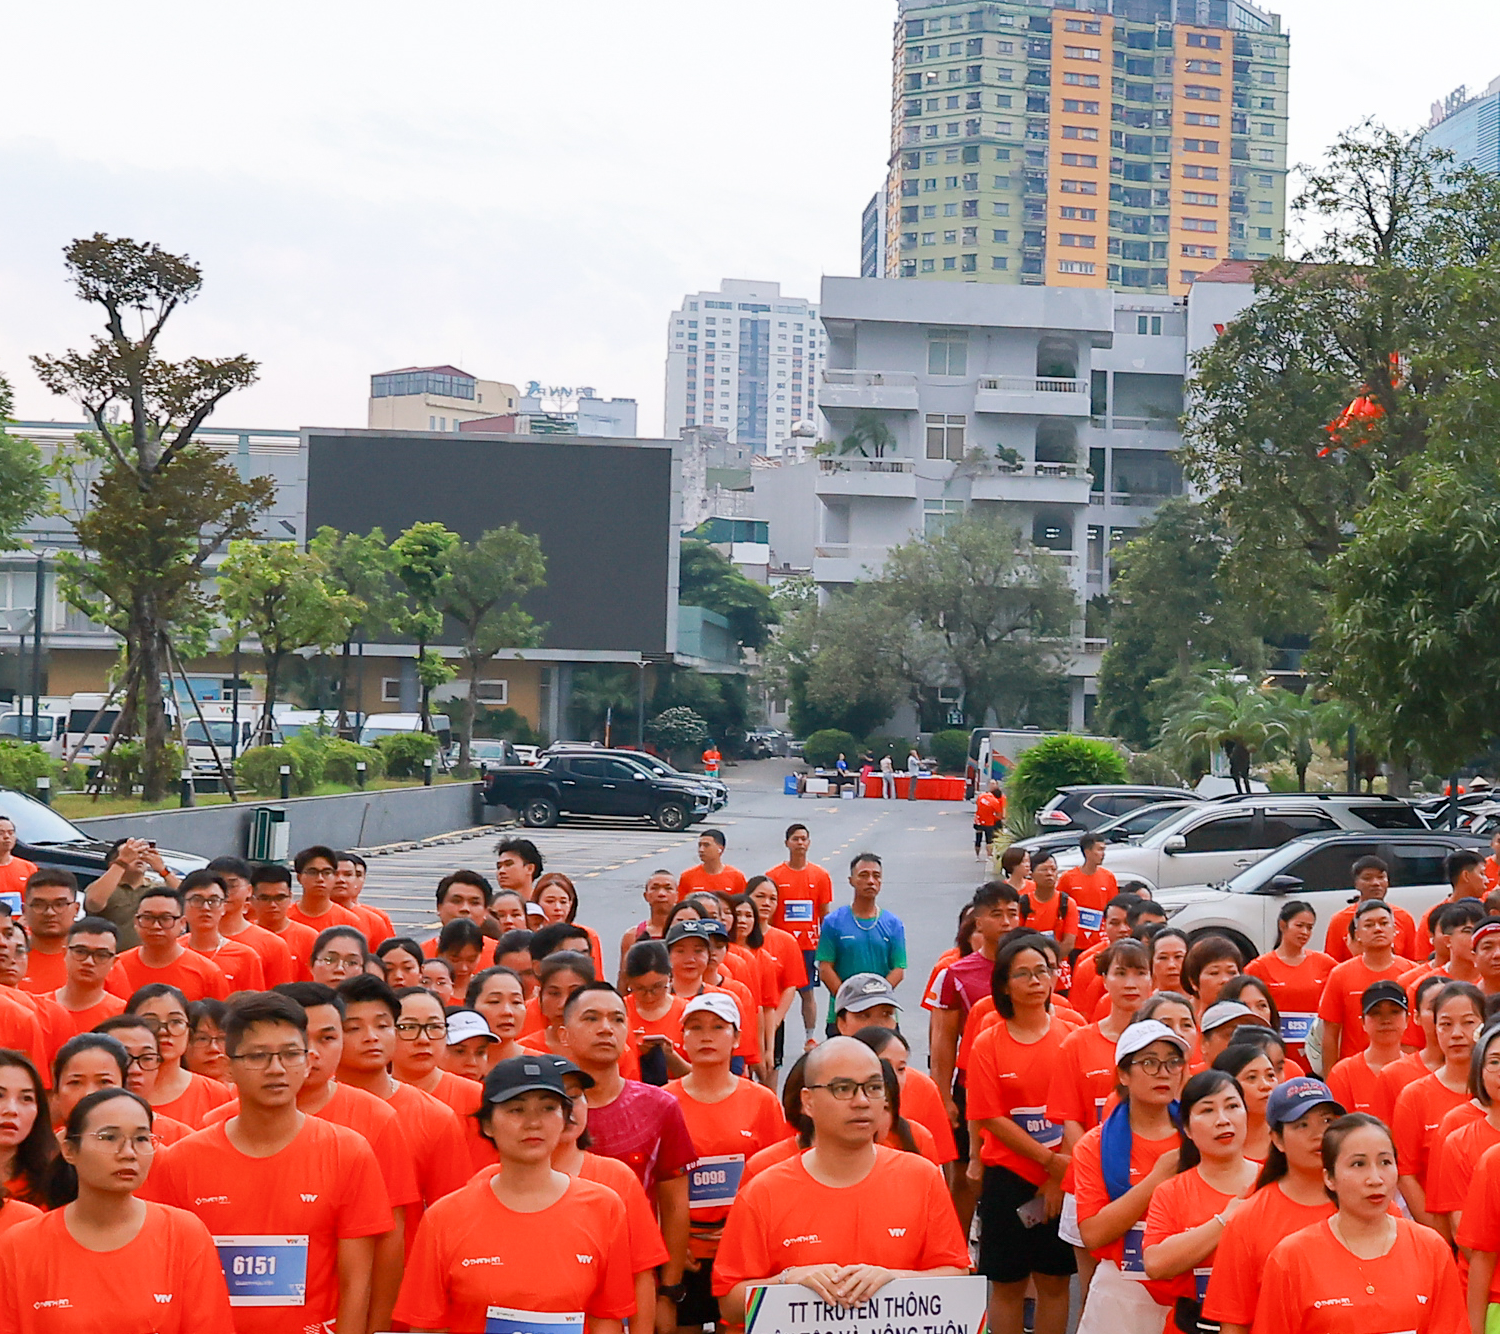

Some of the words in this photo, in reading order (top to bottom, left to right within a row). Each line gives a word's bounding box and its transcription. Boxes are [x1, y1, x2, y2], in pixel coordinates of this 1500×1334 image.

[693, 1169, 726, 1186] 6098
[300, 1193, 318, 1203] VTV
[888, 1228, 906, 1237] VTV
[575, 1254, 593, 1264] VTV
[232, 1255, 276, 1275] 6151
[153, 1294, 172, 1303] VTV
[788, 1301, 808, 1323] TT
[884, 1291, 941, 1318] THÔNG
